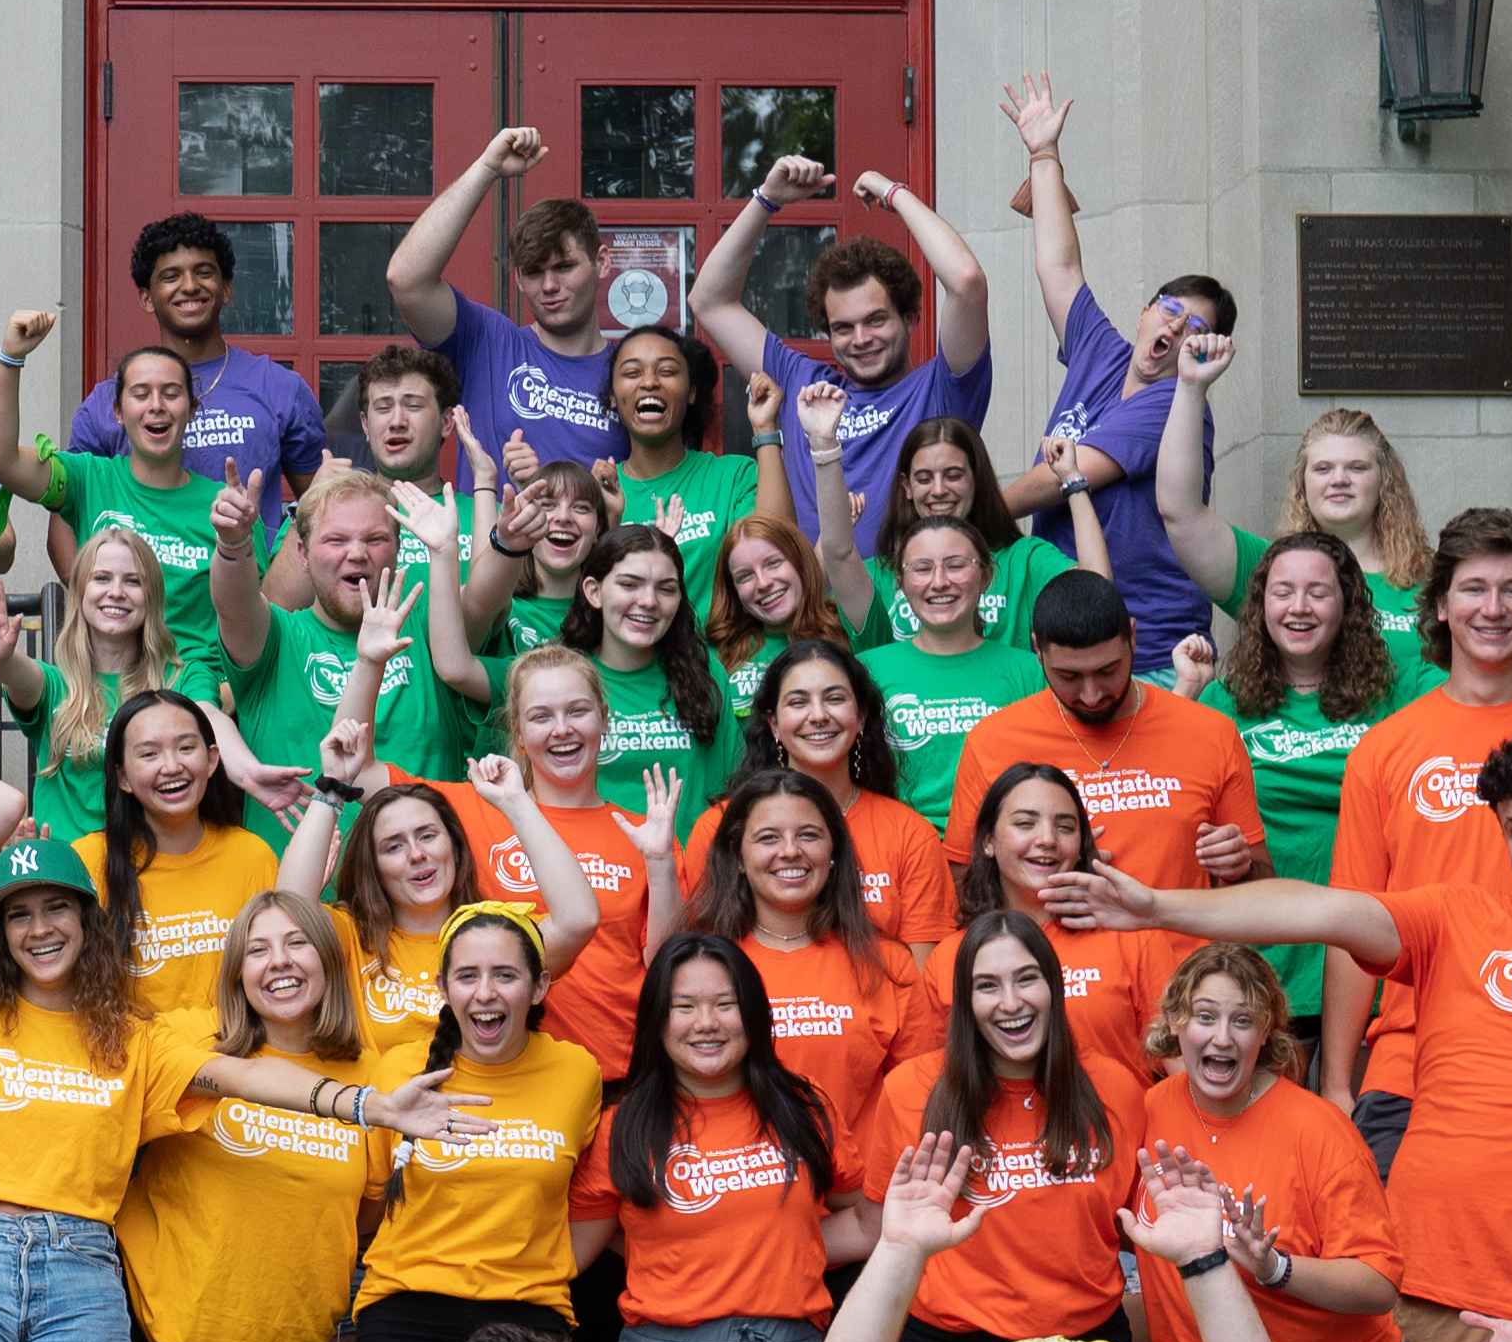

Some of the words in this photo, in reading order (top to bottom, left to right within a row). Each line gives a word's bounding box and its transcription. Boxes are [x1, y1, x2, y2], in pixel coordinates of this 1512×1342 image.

[612, 240, 635, 248] MASK
[636, 240, 662, 248] INSIDE
[613, 233, 636, 241] WEAR
[637, 233, 660, 241] YOUR
[1328, 238, 1352, 248] THE
[1354, 238, 1384, 248] HAAS
[1388, 238, 1438, 248] COLLEGE
[1441, 238, 1483, 249] CENTER
[528, 391, 611, 432] Weekend
[155, 915, 190, 929] Muhlenberg
[190, 909, 214, 924] College
[772, 1000, 854, 1022] ntation
[773, 1016, 844, 1039] ekend
[2, 1077, 113, 1107] Weekend
[227, 1102, 361, 1147] Orientation
[241, 1123, 350, 1163] Weekend
[704, 1145, 744, 1158] Muhlenberg
